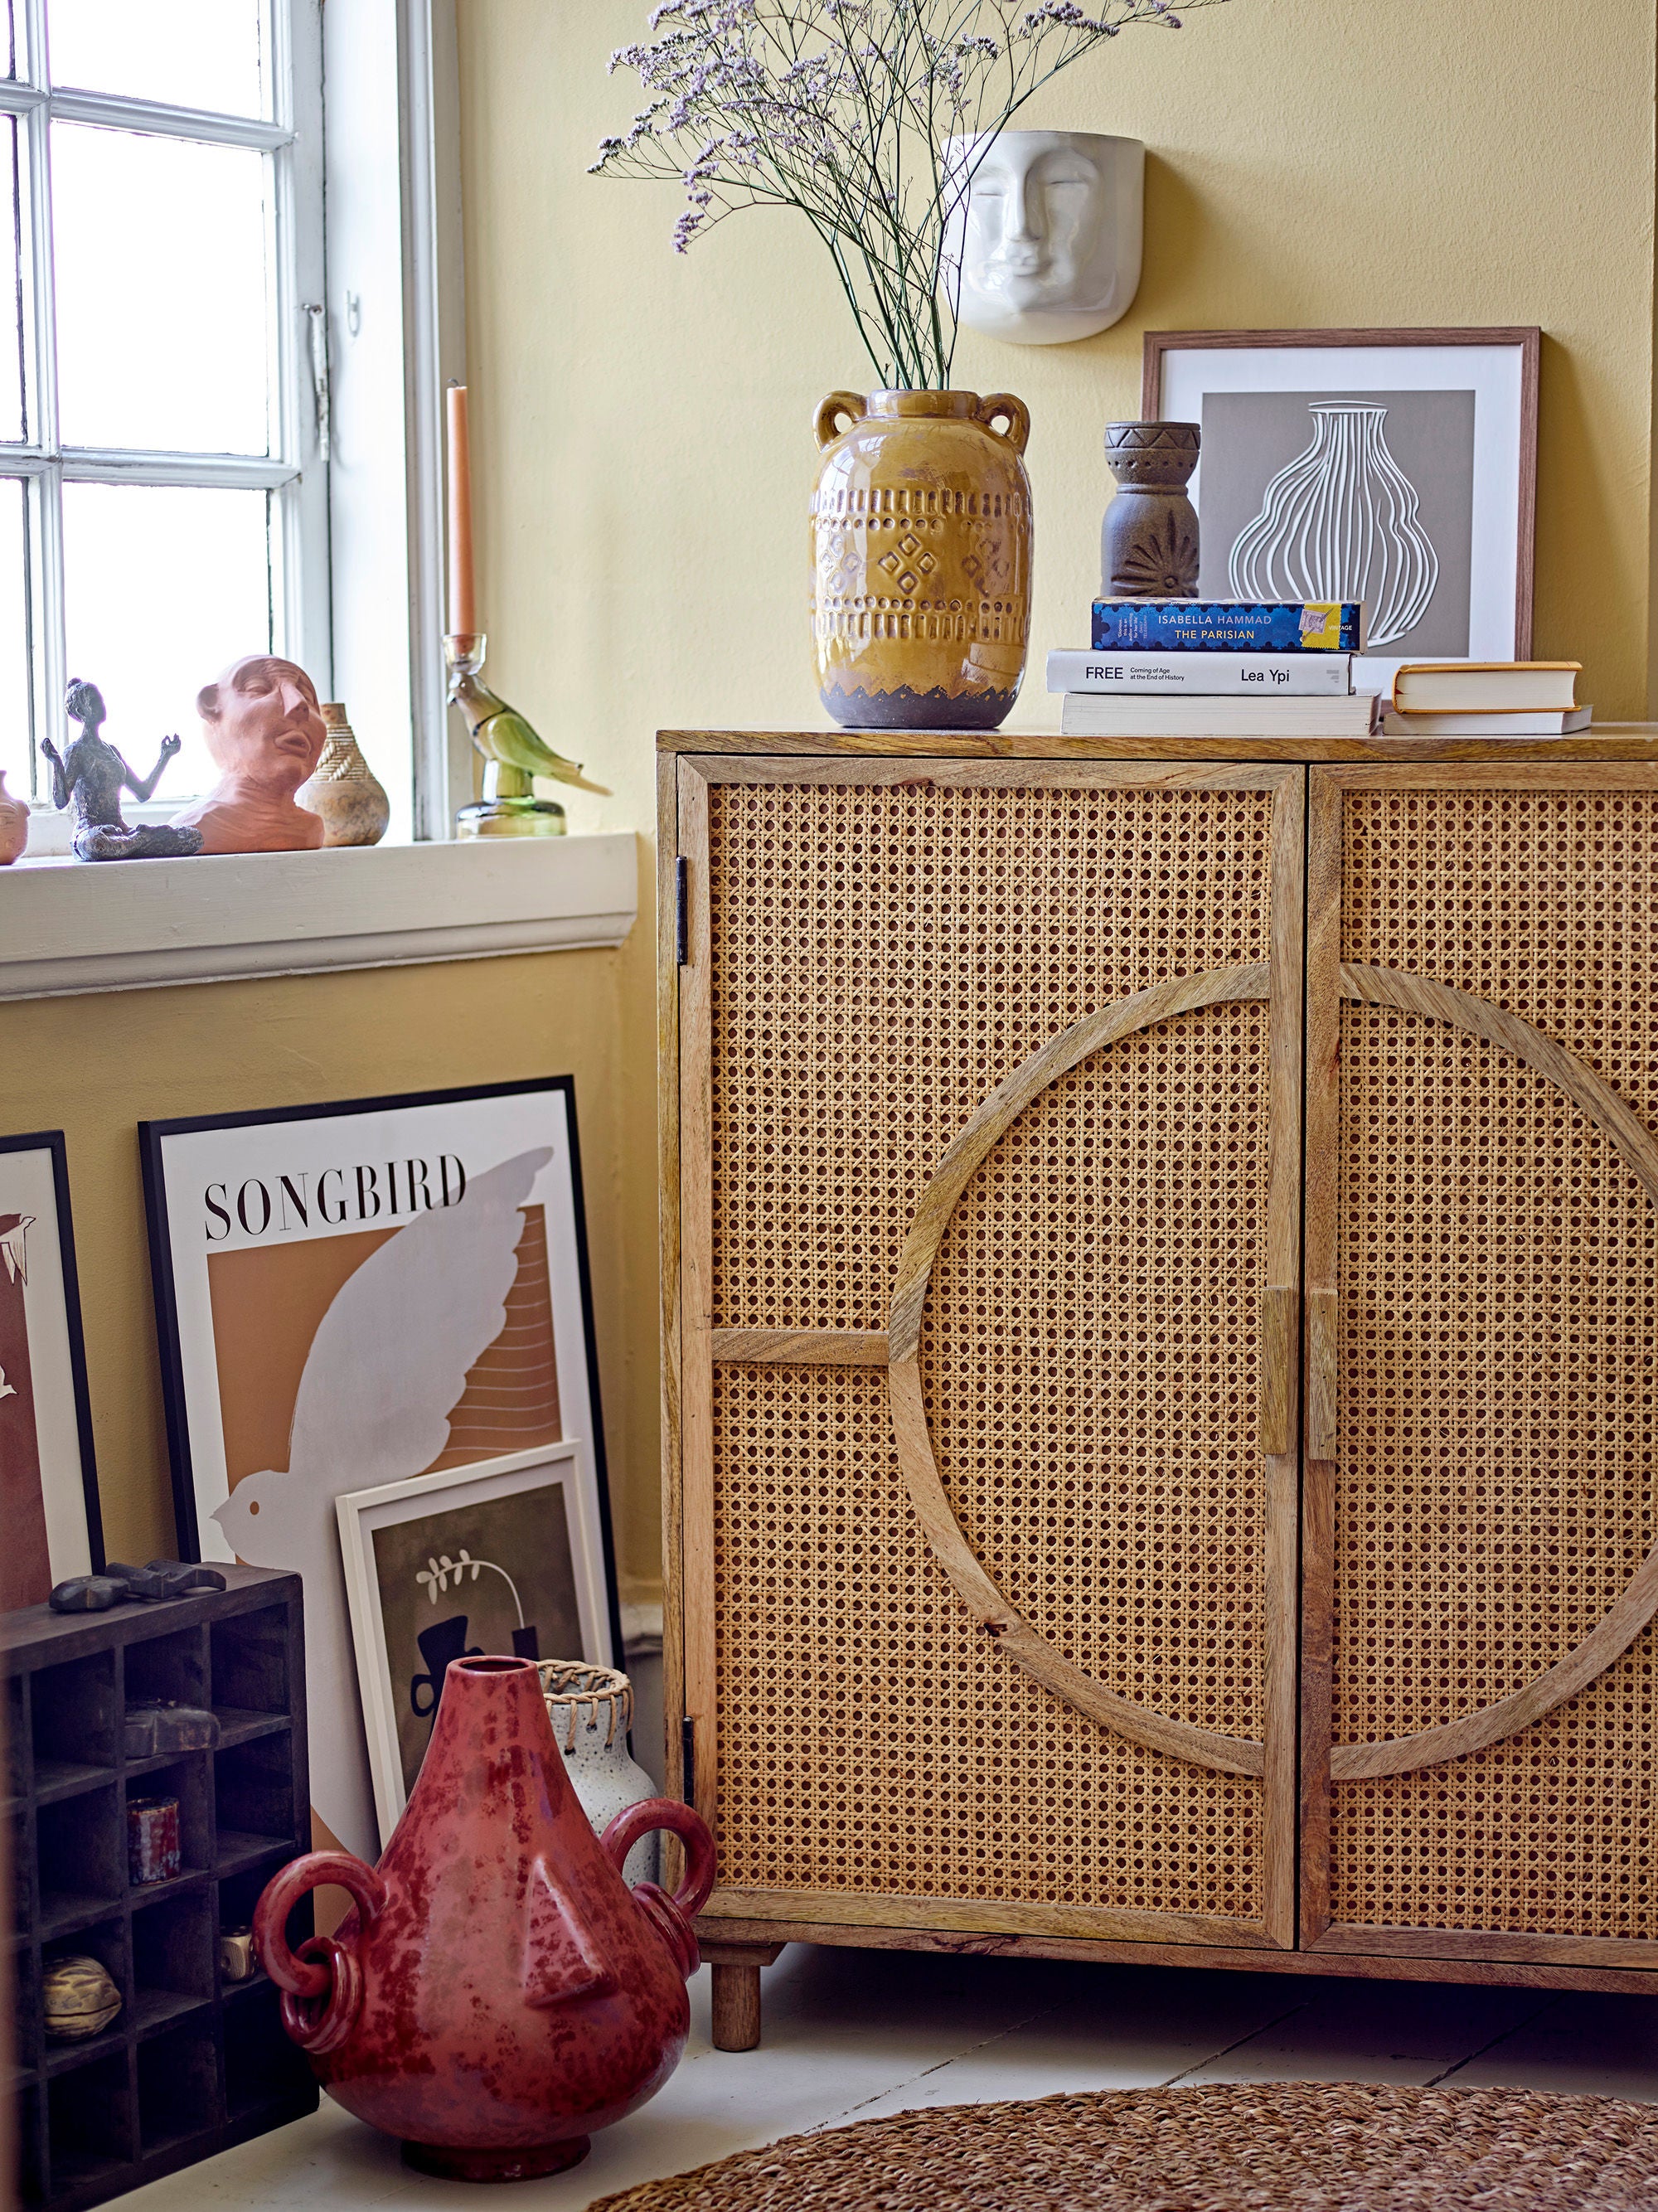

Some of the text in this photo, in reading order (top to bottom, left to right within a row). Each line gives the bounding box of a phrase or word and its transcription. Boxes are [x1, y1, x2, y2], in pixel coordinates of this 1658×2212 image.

[1158, 615, 1272, 624] ISABELLA HAMMAD
[1175, 630, 1254, 639] THE PARISIAN
[1086, 667, 1123, 679] FREE
[1241, 668, 1290, 685] Lea Ypi
[204, 1153, 467, 1241] SONGBIRD
